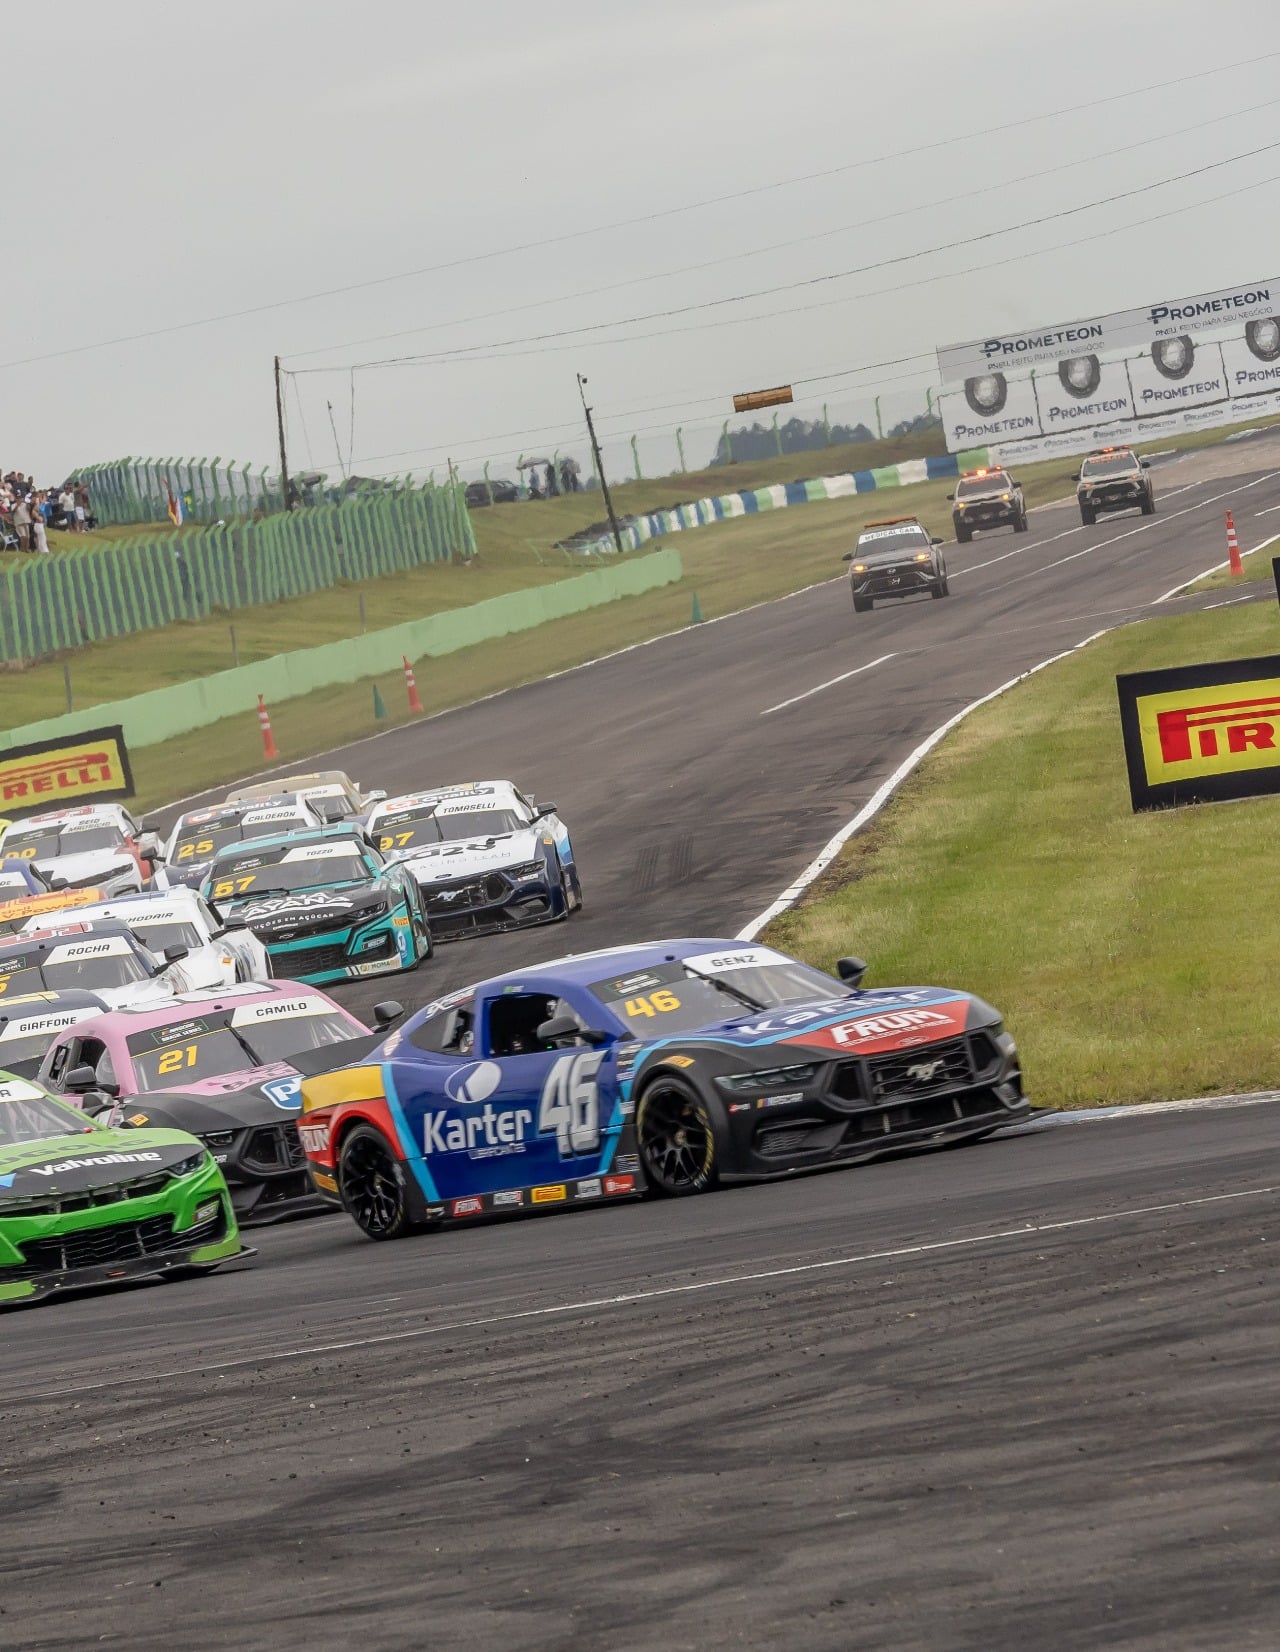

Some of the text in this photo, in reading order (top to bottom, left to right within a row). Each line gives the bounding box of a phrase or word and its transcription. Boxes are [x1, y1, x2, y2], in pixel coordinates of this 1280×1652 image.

[1147, 290, 1270, 325] PROMETEON
[980, 324, 1104, 358] PROMETEON
[1141, 379, 1220, 404] PROMETEON
[1048, 398, 1128, 422] PROMETEON
[952, 415, 1034, 440] PROMETEON
[443, 802, 496, 814] TOMASELLI
[178, 839, 214, 859] 25
[380, 831, 415, 851] 97
[214, 875, 257, 897] 57
[125, 912, 174, 923] HODAIR
[67, 944, 111, 957] ROCHA
[711, 955, 758, 967] GENZ
[256, 1002, 307, 1017] CAMILO
[625, 990, 682, 1018] 46
[20, 1016, 77, 1032] GIAFFONE
[830, 1009, 950, 1044] FRUM
[158, 1045, 198, 1075] 21
[539, 1050, 608, 1155] 46
[424, 1104, 533, 1154] Karter
[29, 1150, 162, 1177] Valvoline
